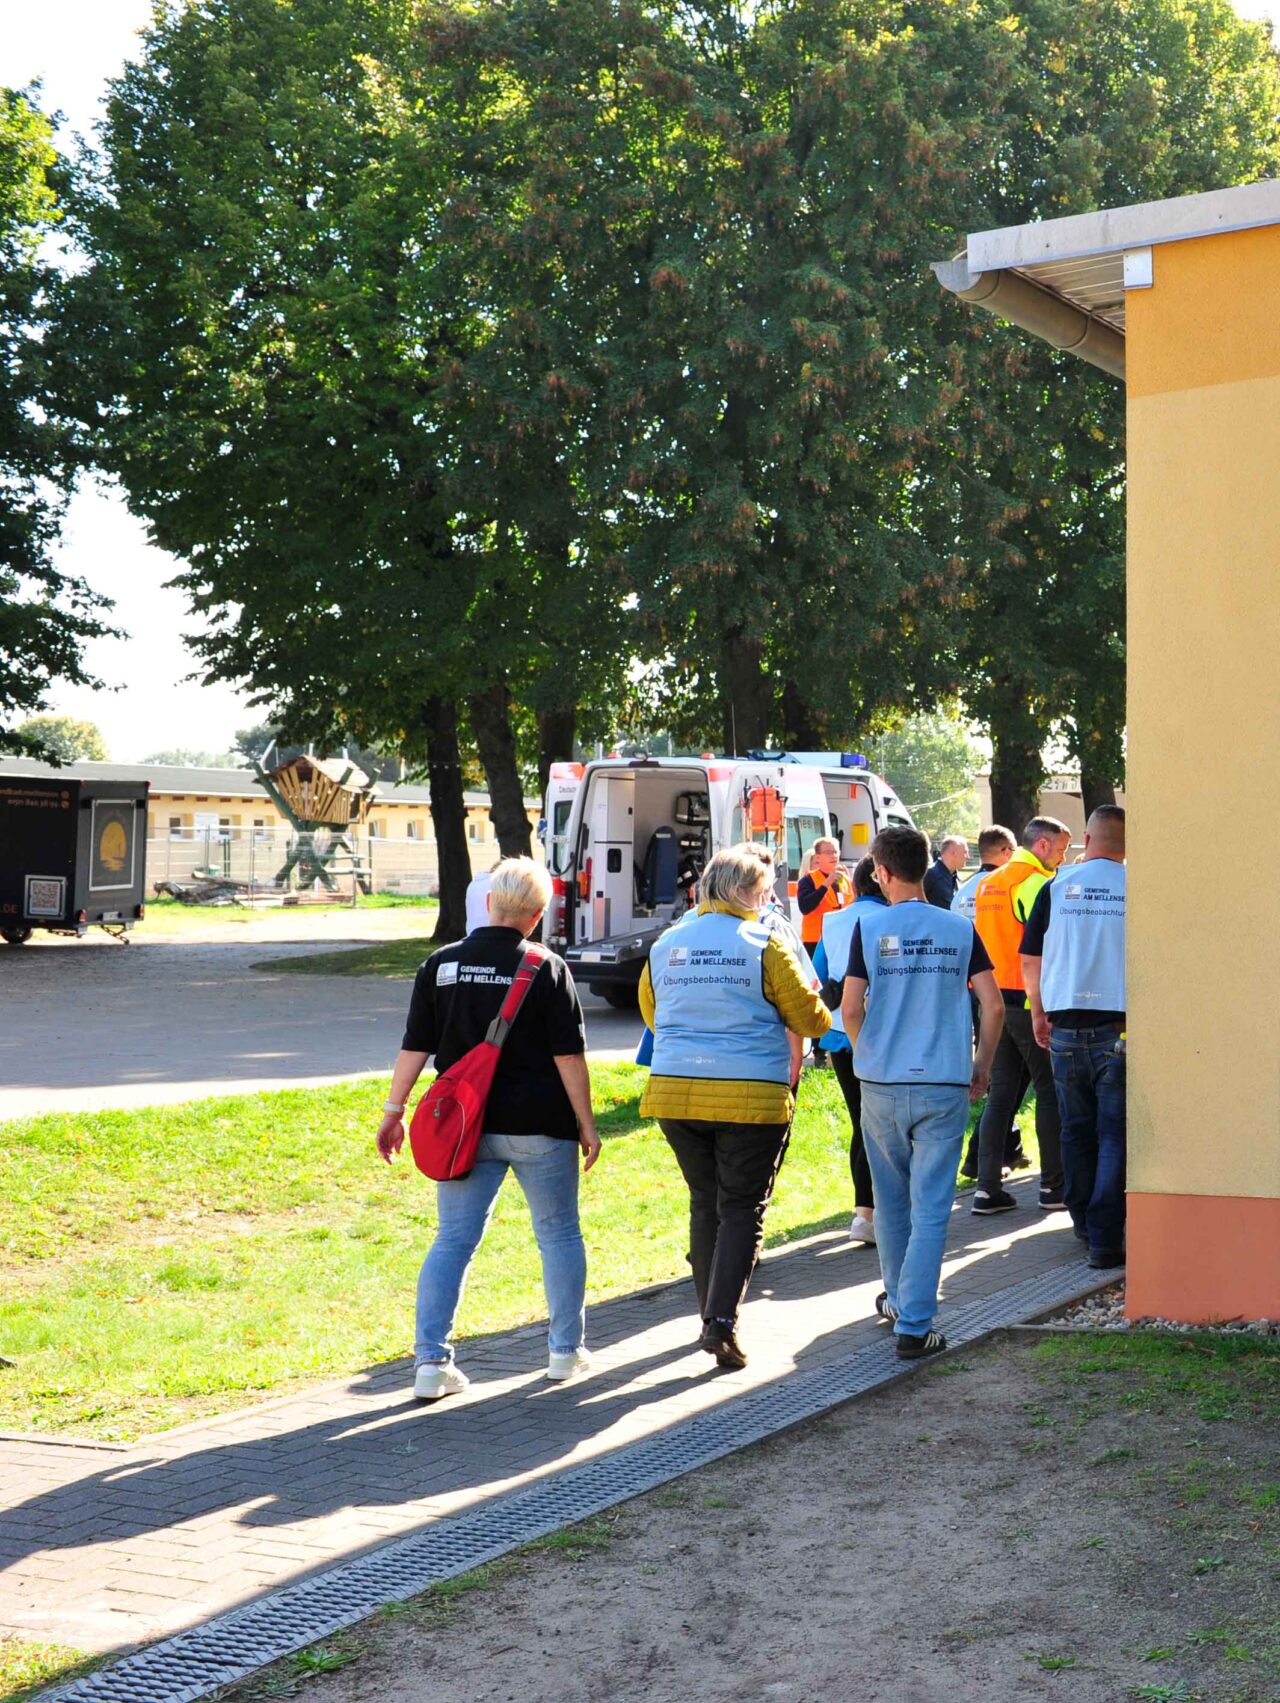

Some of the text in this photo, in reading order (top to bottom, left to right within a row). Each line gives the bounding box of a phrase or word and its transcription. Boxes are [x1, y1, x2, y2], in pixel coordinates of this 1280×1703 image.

[1094, 895, 1126, 903] MELLENSE
[691, 949, 722, 957] GEMEINDE
[916, 947, 958, 956] MELLENSEE
[690, 958, 701, 966] AM
[702, 958, 747, 966] MELLENSEE
[460, 965, 496, 974] GEMEINDE
[877, 965, 960, 976] Übungsbeobachtung
[459, 974, 472, 982] AM
[473, 975, 513, 985] MELLENS
[663, 974, 751, 987] Übungsbeobachtung
